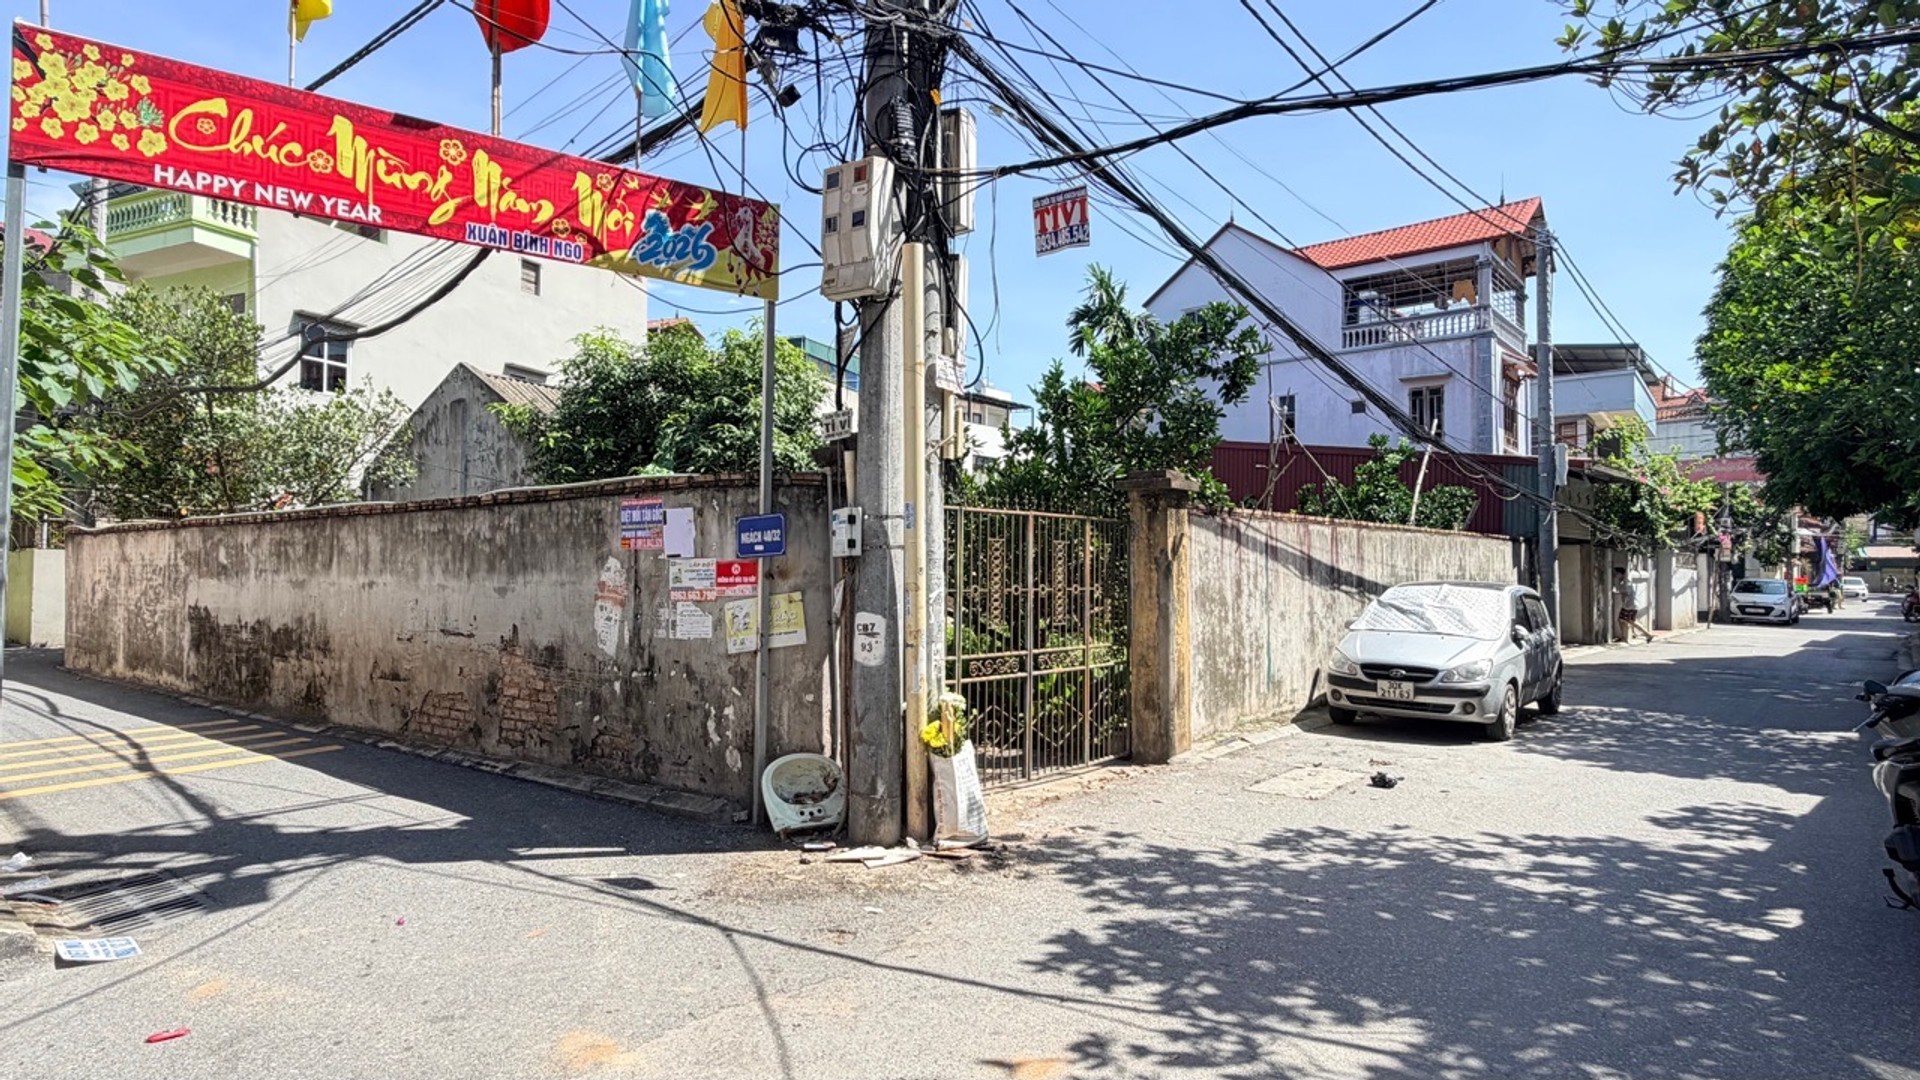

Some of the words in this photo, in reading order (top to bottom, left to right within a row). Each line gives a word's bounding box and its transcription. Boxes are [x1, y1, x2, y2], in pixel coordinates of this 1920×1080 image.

[154, 163, 247, 197] HAPPY
[254, 182, 314, 210] NEW
[320, 195, 382, 222] YEAR
[168, 97, 310, 167] Chúc
[472, 148, 555, 224] Năm
[571, 171, 635, 252] Mới
[466, 221, 509, 247] XUÂN
[553, 239, 582, 264] NGỌ
[636, 221, 717, 271] 2026
[740, 528, 762, 545] NGÁCH
